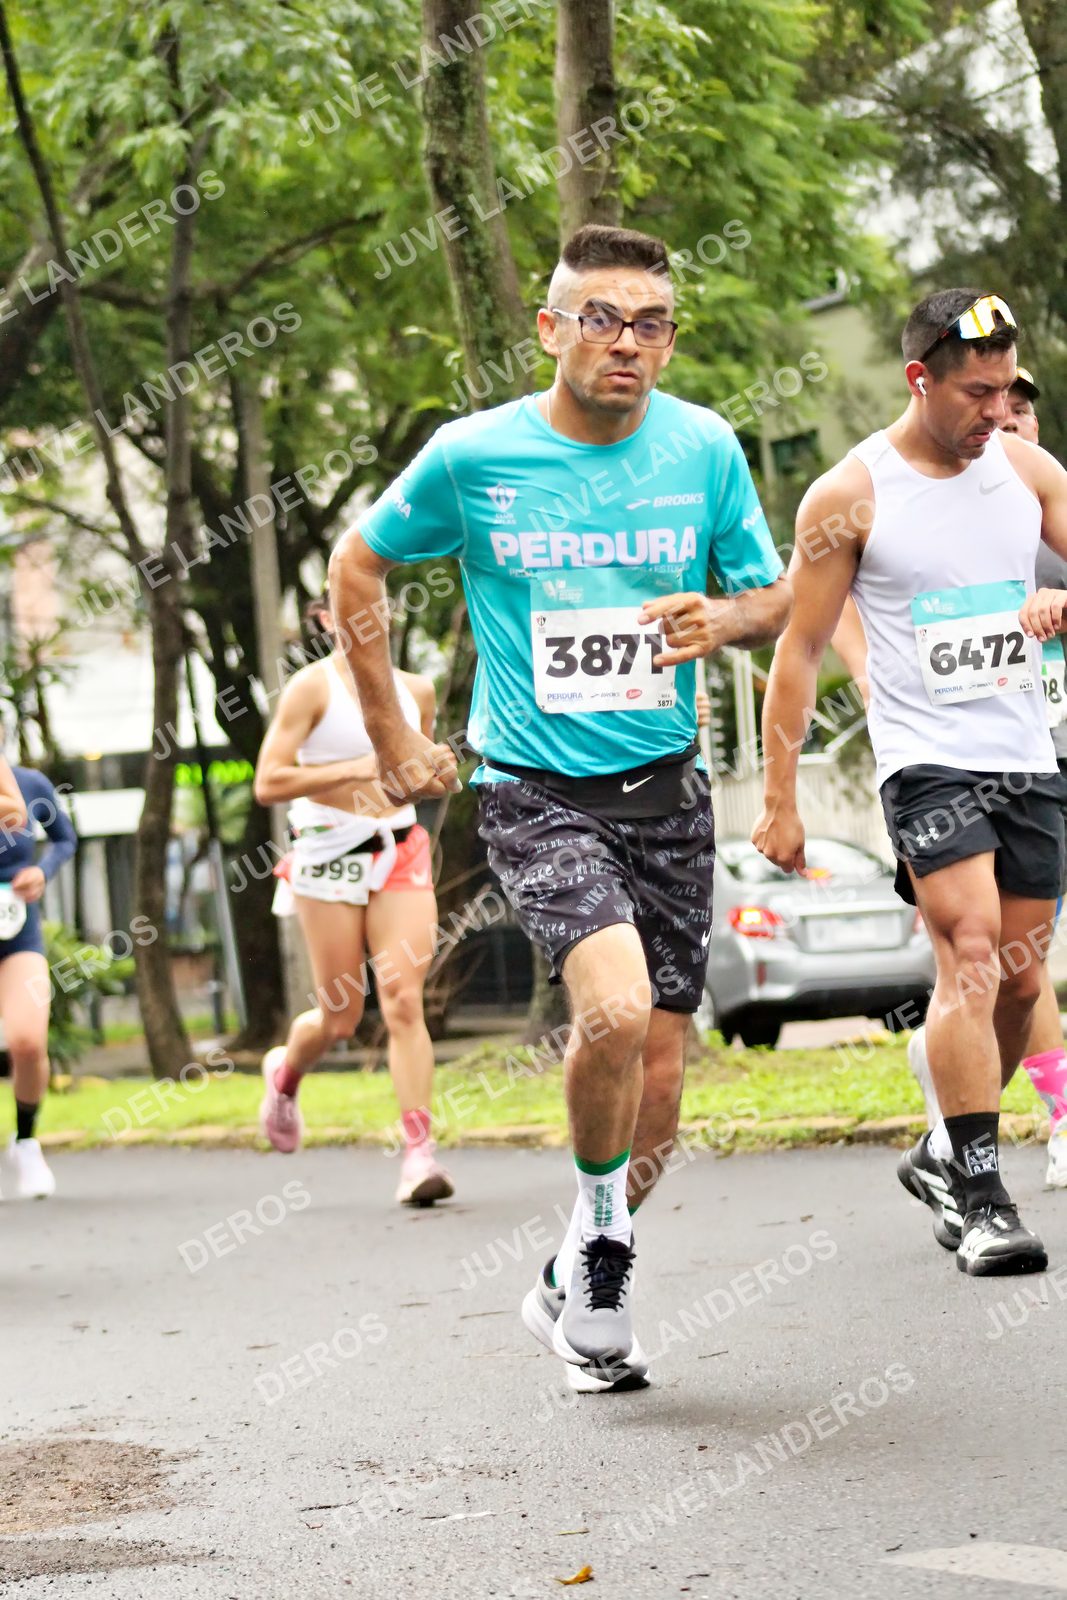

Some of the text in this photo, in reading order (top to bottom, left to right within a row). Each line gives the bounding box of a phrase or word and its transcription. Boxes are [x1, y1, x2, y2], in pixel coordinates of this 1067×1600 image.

[653, 492, 704, 508] BROOKS
[490, 525, 697, 568] PERDURA
[545, 634, 663, 678] 3871
[929, 631, 1026, 676] 6472
[301, 860, 363, 883] 999
